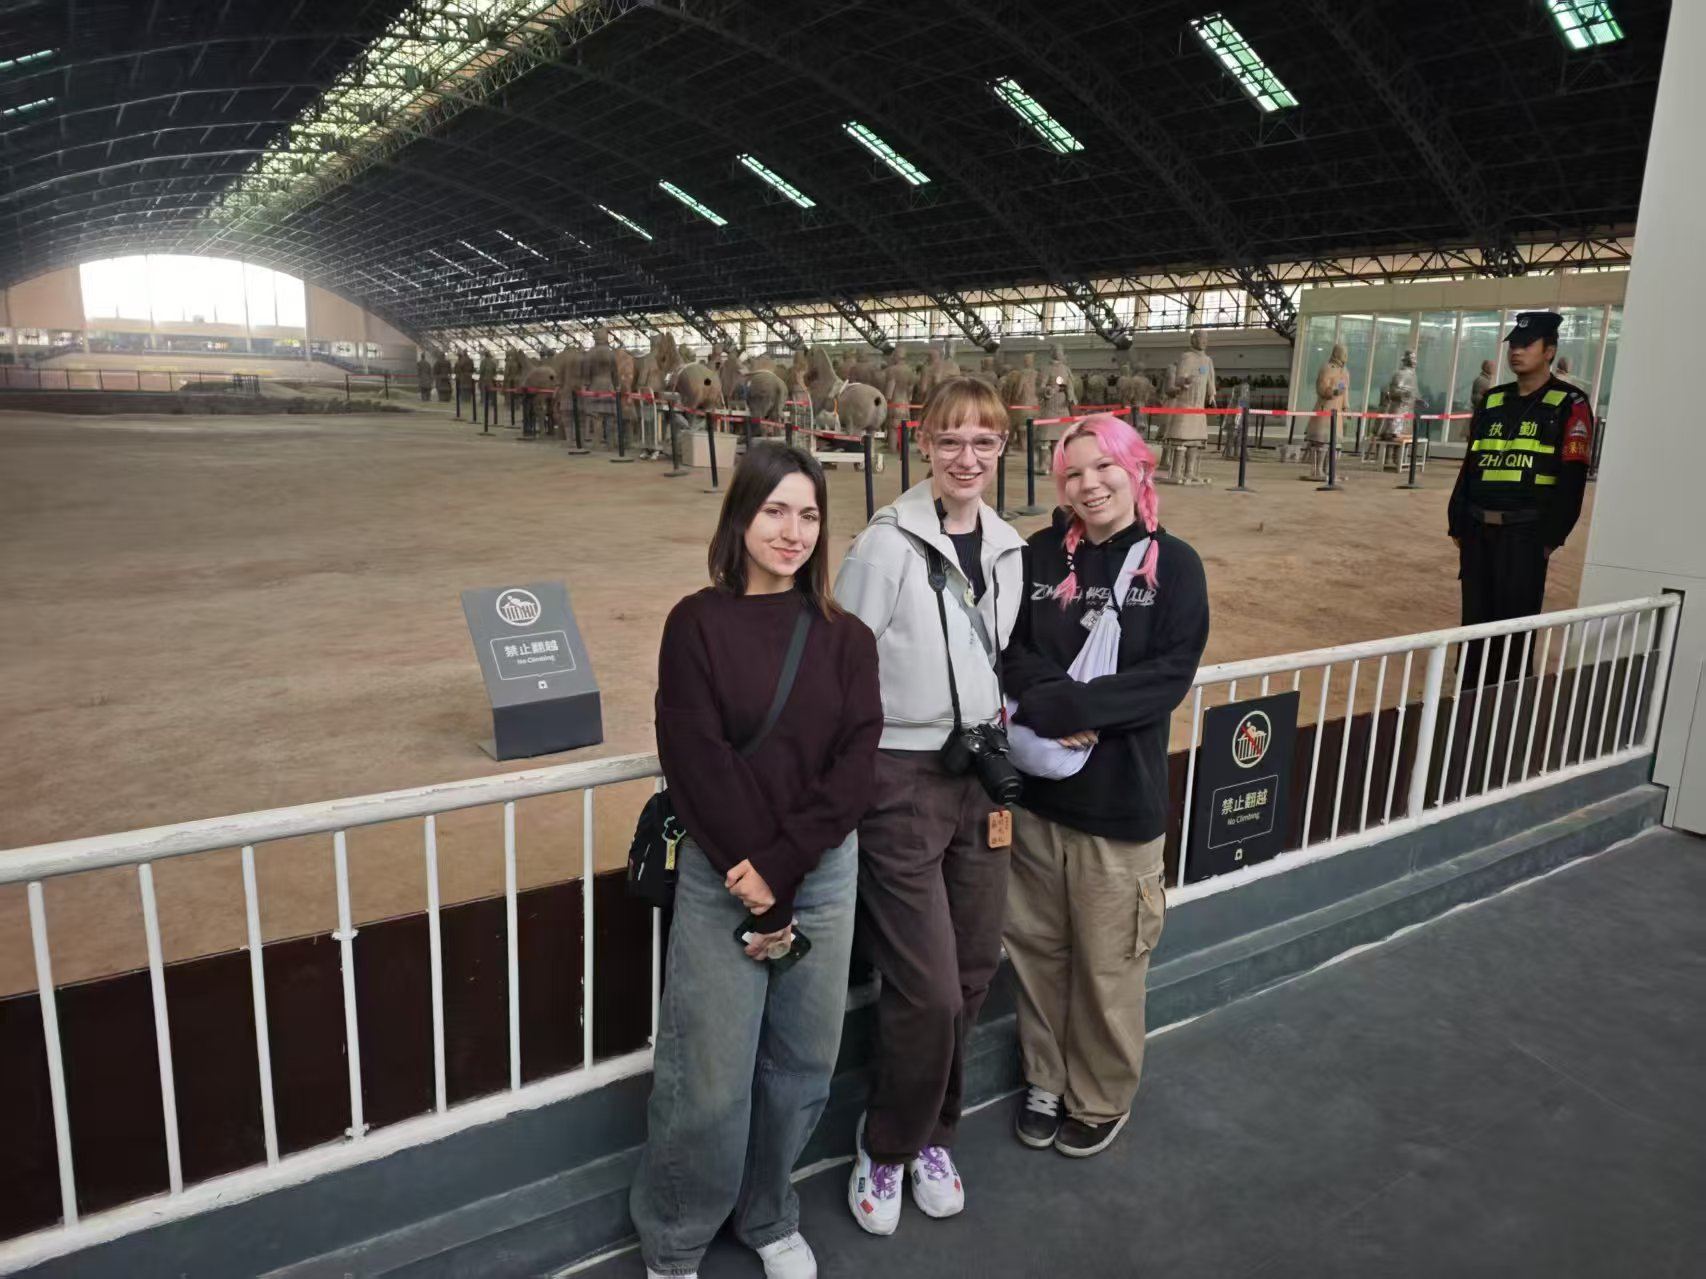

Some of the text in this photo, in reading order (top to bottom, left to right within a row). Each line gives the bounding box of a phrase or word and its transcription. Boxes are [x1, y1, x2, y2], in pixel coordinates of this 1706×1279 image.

[1478, 454, 1533, 468] ZHI QIN
[527, 655, 555, 664] Climbing
[1221, 789, 1268, 815] 禁止翻越
[1227, 812, 1260, 826] No Climbing
